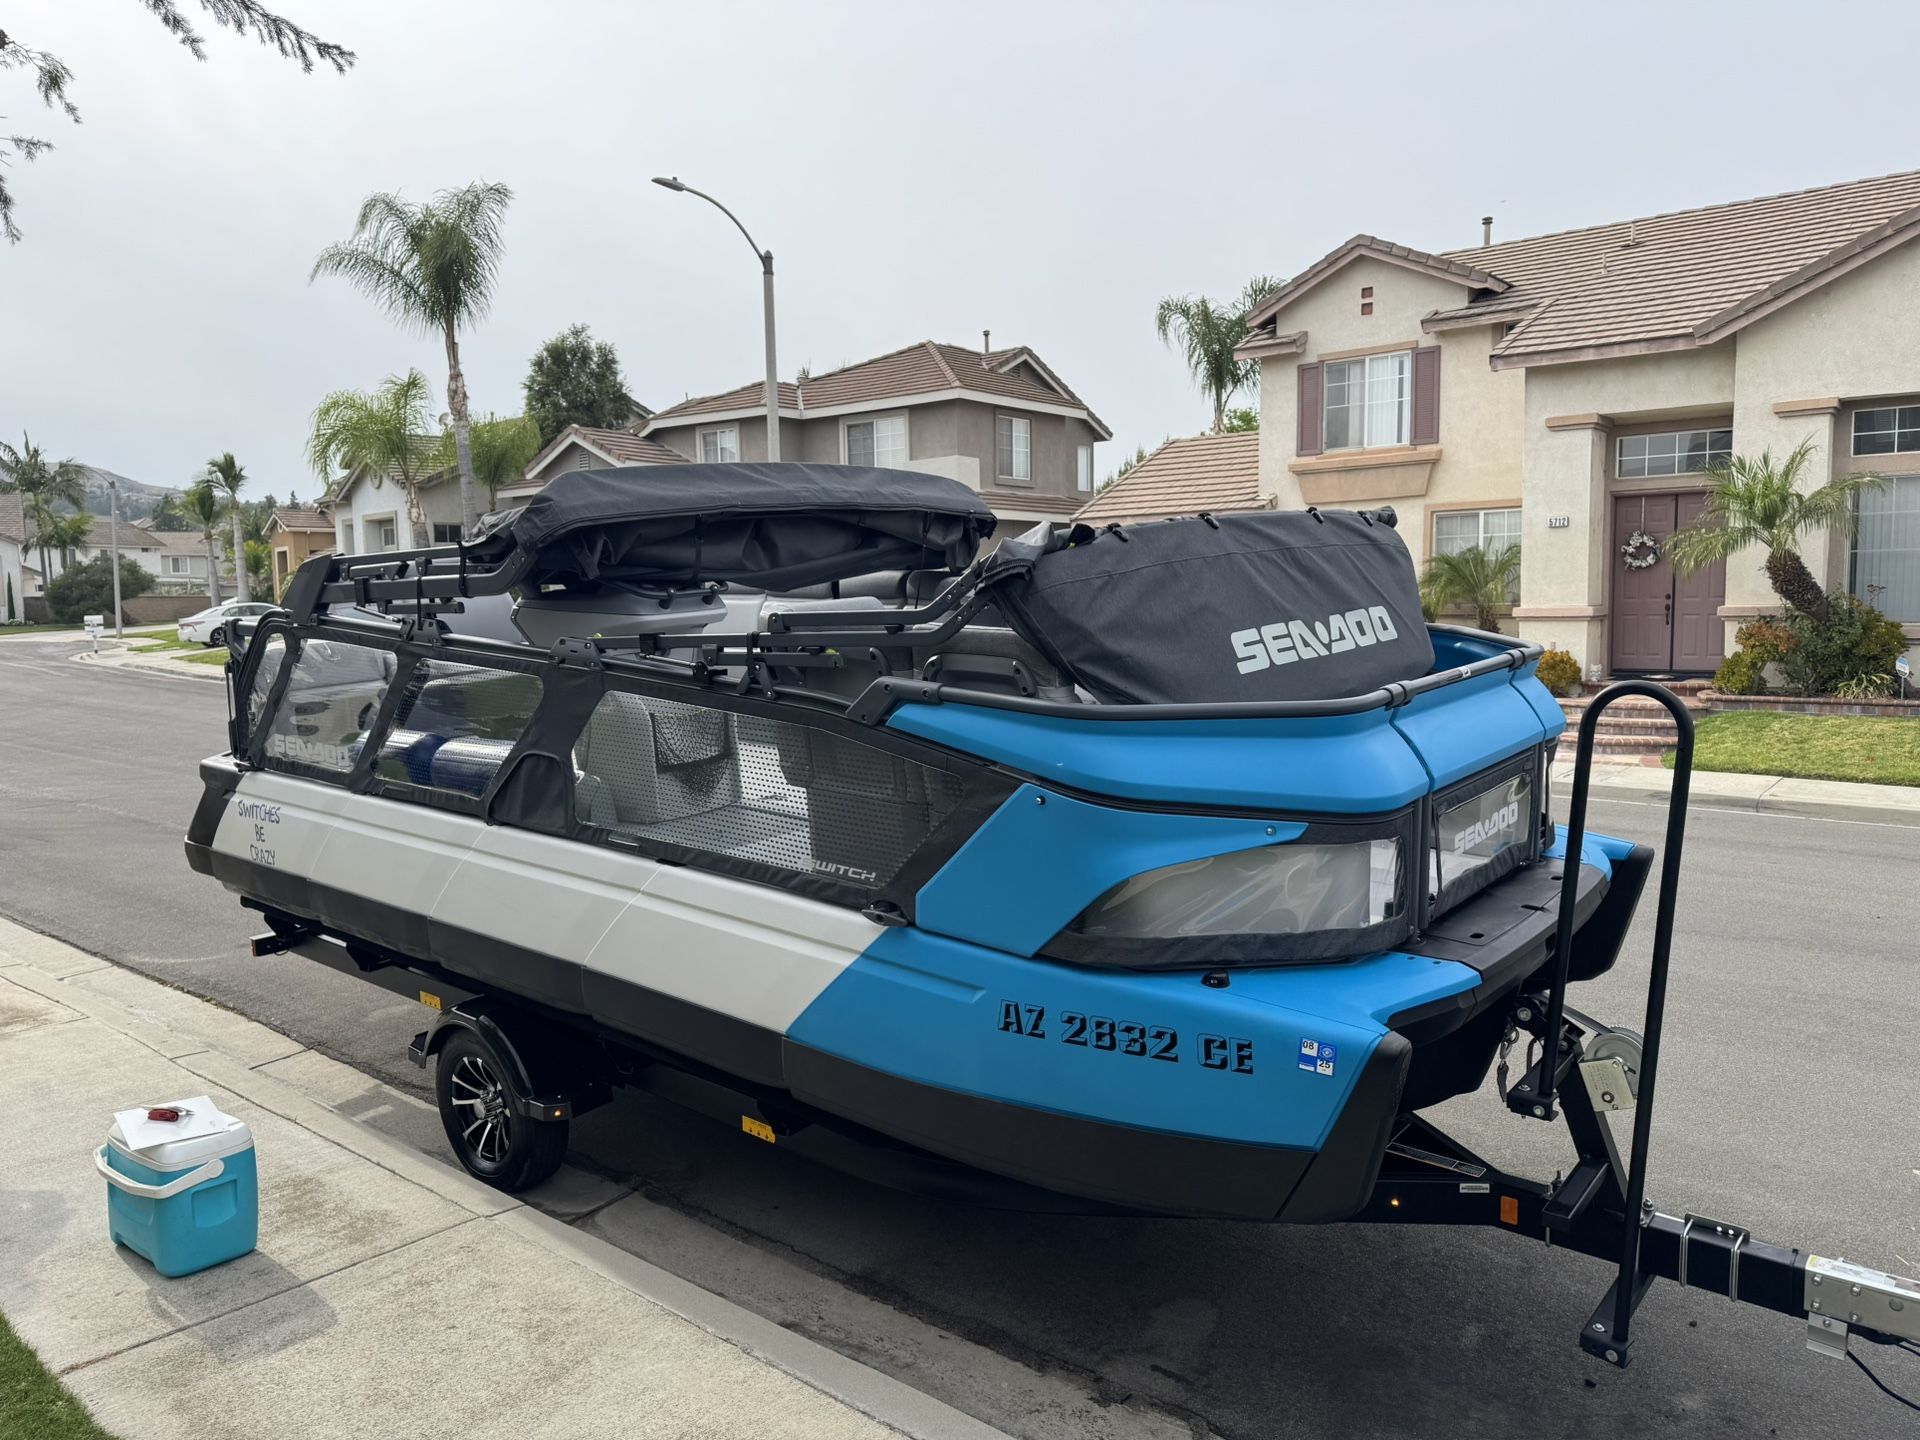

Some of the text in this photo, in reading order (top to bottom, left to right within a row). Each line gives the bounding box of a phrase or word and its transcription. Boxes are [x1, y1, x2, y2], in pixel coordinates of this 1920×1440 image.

[1548, 516, 1567, 527] 5712
[237, 799, 281, 825] SWITCHES
[254, 823, 266, 843] BE
[249, 843, 276, 866] CRAZY
[998, 999, 1045, 1039] AZ
[1060, 1010, 1179, 1063] 2832
[1302, 1040, 1315, 1050] 08
[1318, 1059, 1331, 1069] 25
